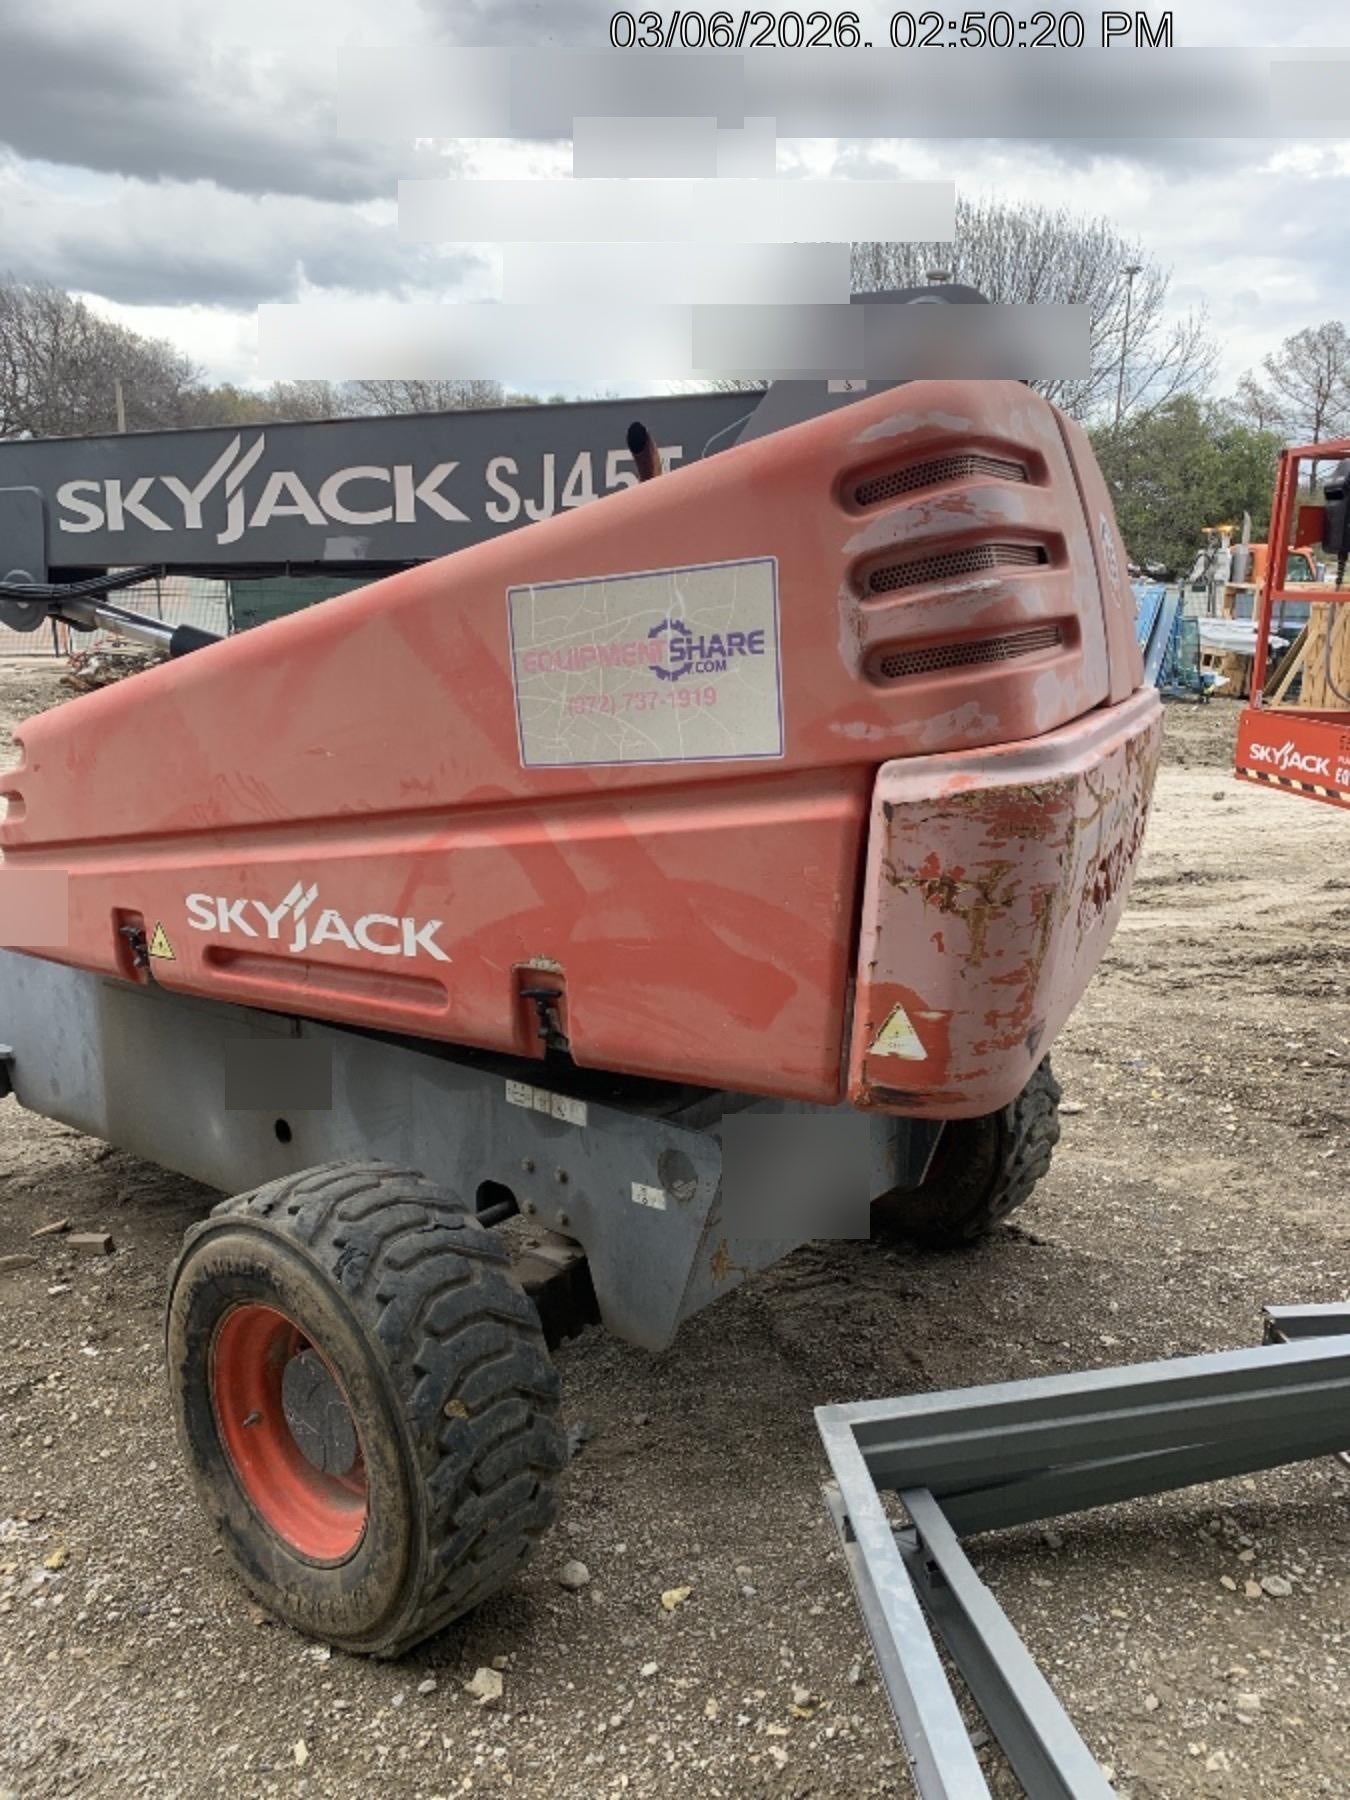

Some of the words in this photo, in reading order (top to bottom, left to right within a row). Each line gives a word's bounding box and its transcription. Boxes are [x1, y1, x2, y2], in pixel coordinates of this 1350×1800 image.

[56, 432, 472, 545] SKYJACK
[1249, 741, 1331, 777] SKYJACK
[184, 880, 453, 962] SKYJACK
